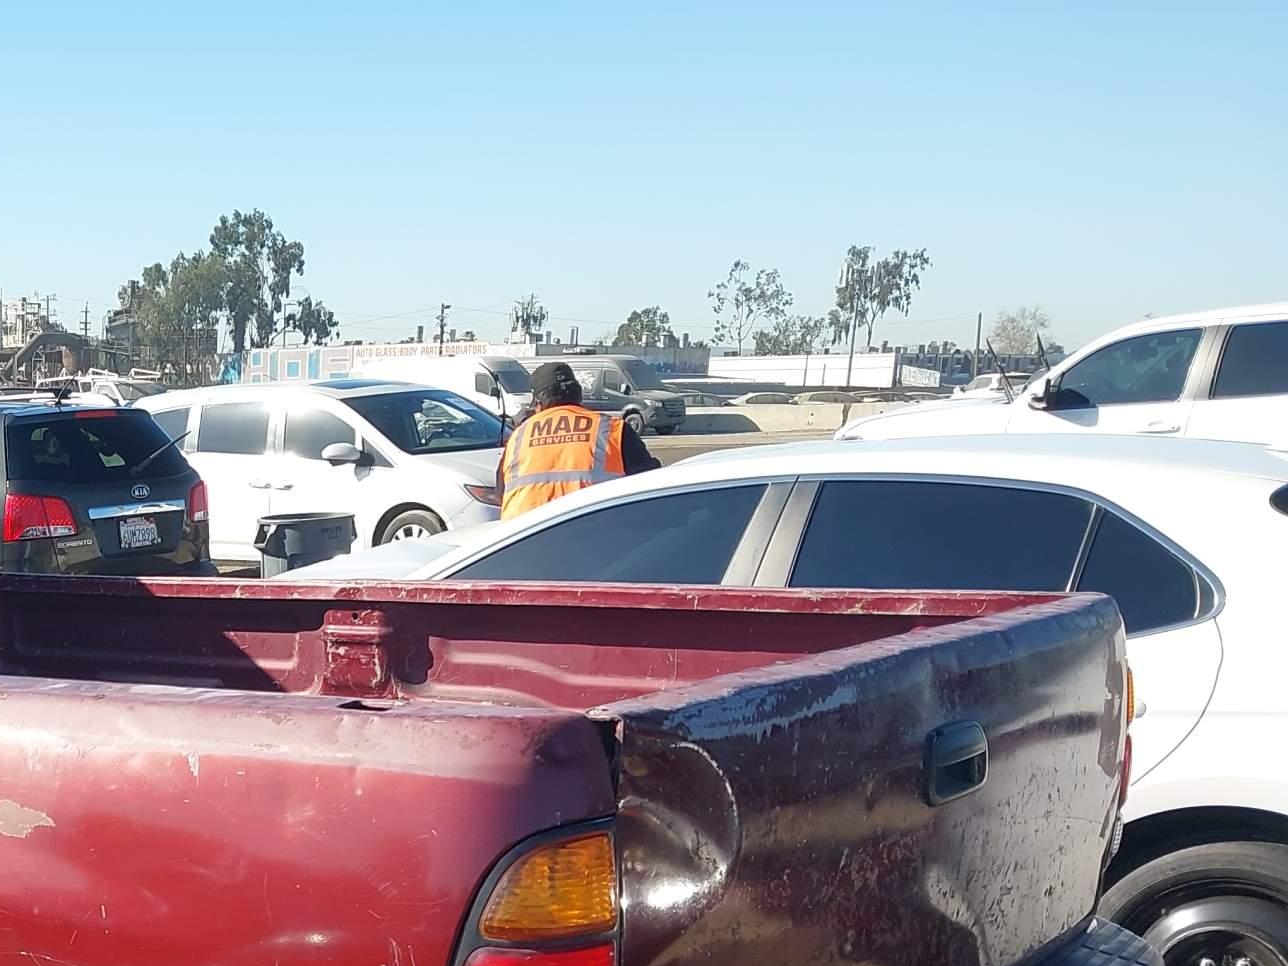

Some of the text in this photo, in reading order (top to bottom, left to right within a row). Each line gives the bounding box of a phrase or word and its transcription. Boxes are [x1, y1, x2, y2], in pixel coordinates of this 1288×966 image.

[355, 347, 373, 357] AUTO
[530, 415, 593, 438] MAD
[531, 433, 587, 445] SERVICES
[133, 487, 148, 497] KIA
[56, 539, 92, 549] SORENTO
